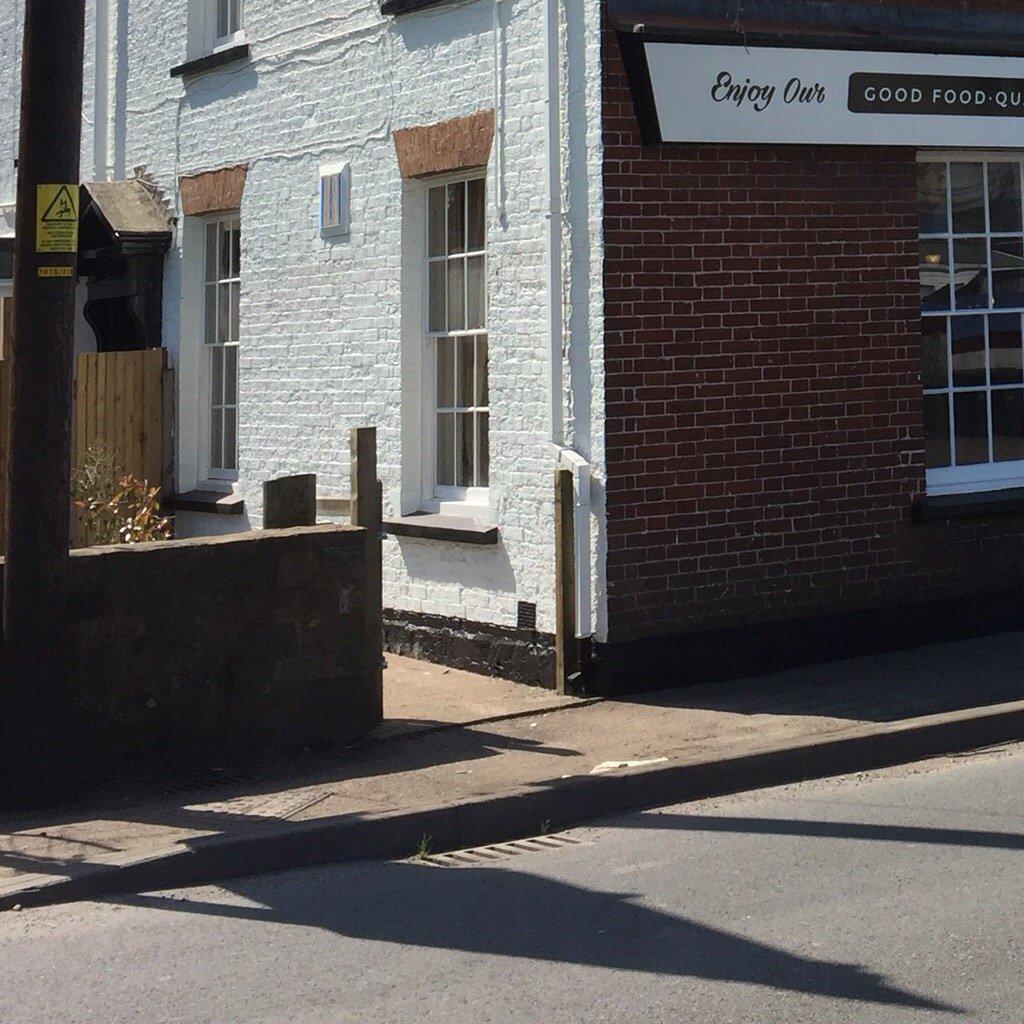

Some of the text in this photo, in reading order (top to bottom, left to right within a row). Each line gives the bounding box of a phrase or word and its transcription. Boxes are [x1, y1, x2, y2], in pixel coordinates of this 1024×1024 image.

[711, 71, 826, 112] Enjoy Our
[864, 86, 923, 103] GOOD
